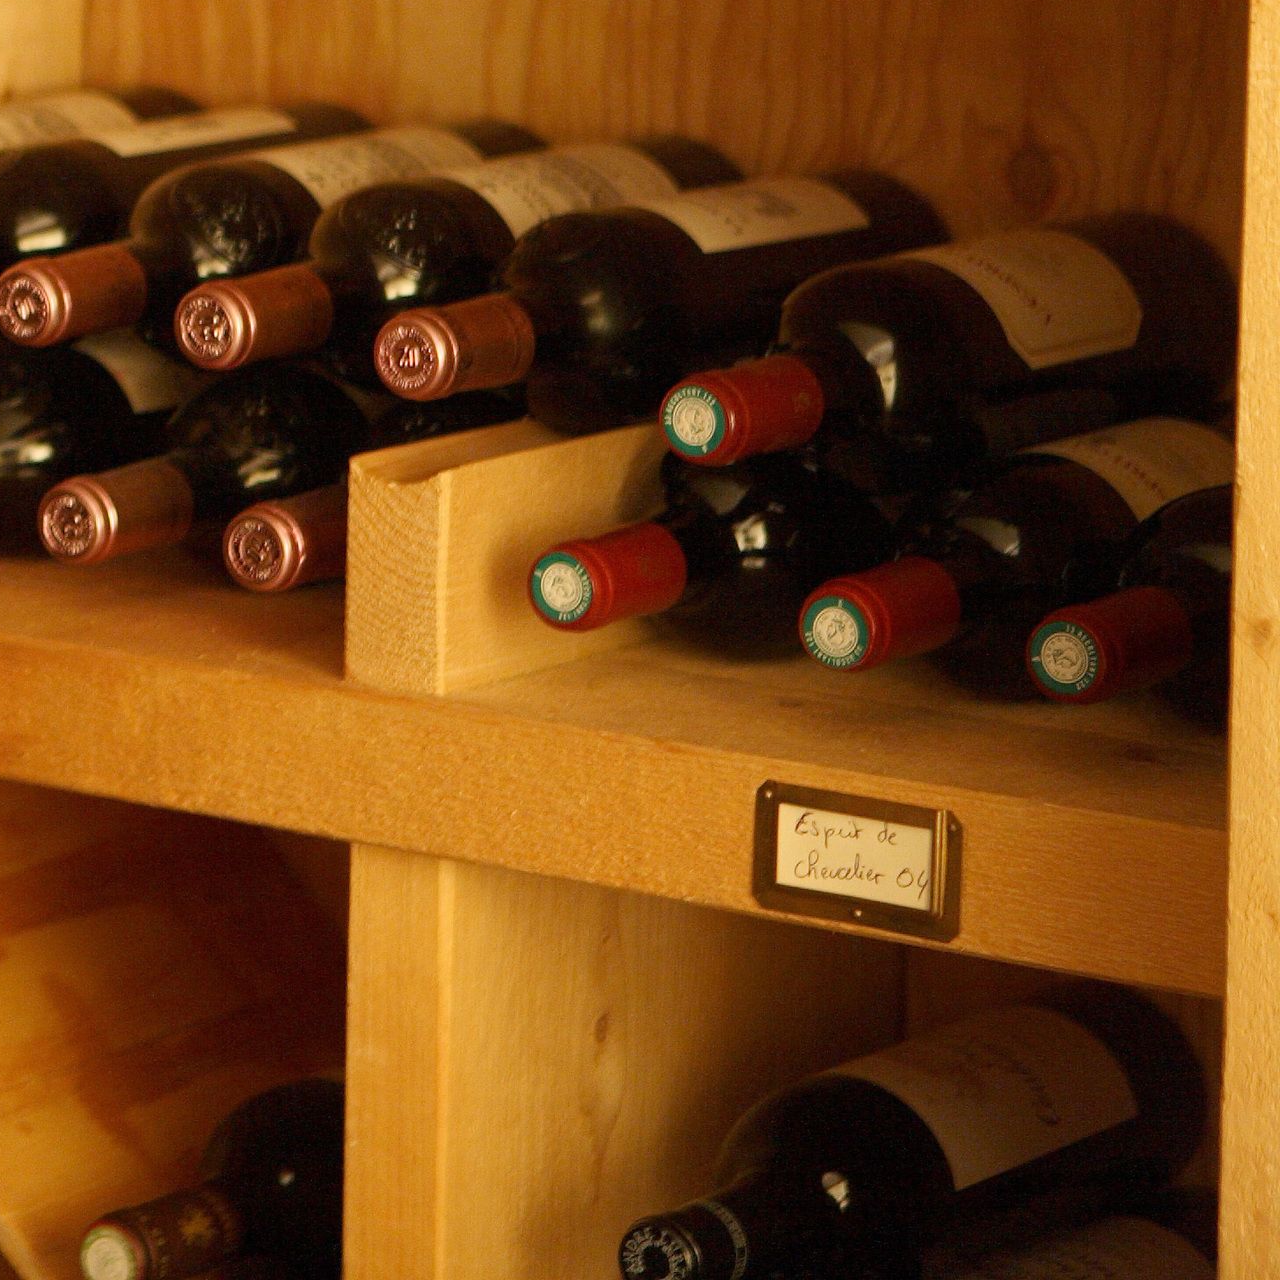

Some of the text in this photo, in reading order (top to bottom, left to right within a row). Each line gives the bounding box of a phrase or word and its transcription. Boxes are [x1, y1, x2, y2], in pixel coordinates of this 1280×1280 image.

[794, 810, 897, 848] Esprit de
[895, 867, 929, 900] 04
